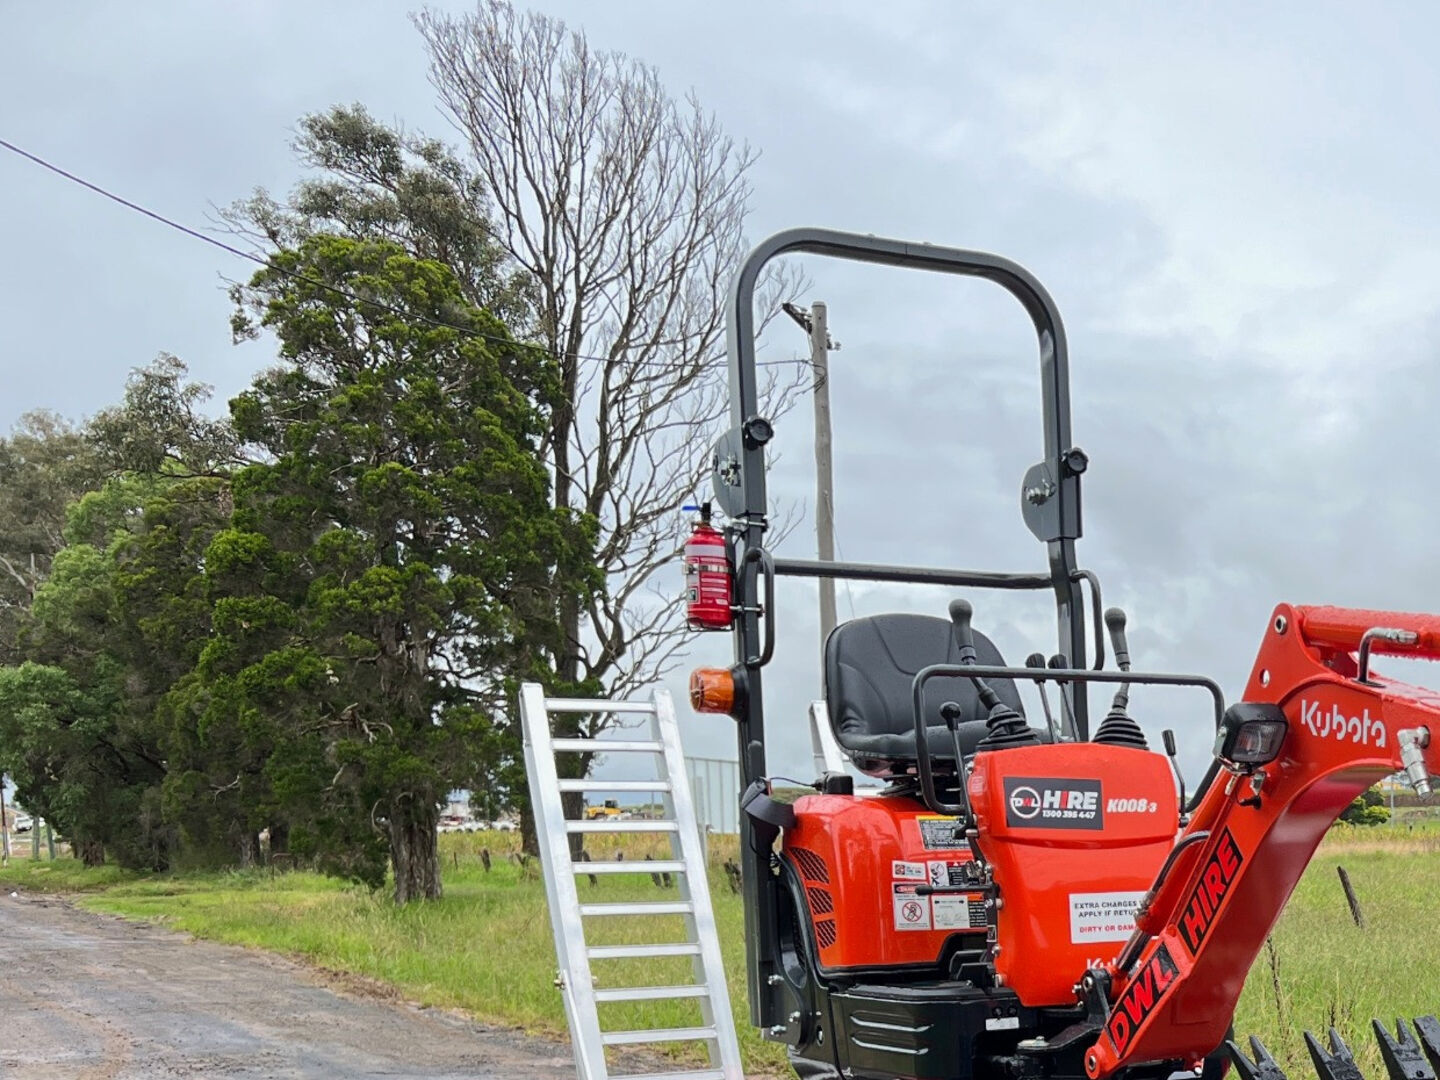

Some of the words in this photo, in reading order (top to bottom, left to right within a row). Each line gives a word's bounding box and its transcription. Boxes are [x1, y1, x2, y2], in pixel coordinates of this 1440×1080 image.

[1300, 699, 1387, 748] Kubota
[1043, 790, 1099, 810] HIRE
[1102, 900, 1137, 908] CHARGES
[1080, 925, 1102, 933] DIRTY
[1109, 957, 1174, 1053] DWL
[1183, 835, 1239, 950] HIRE
